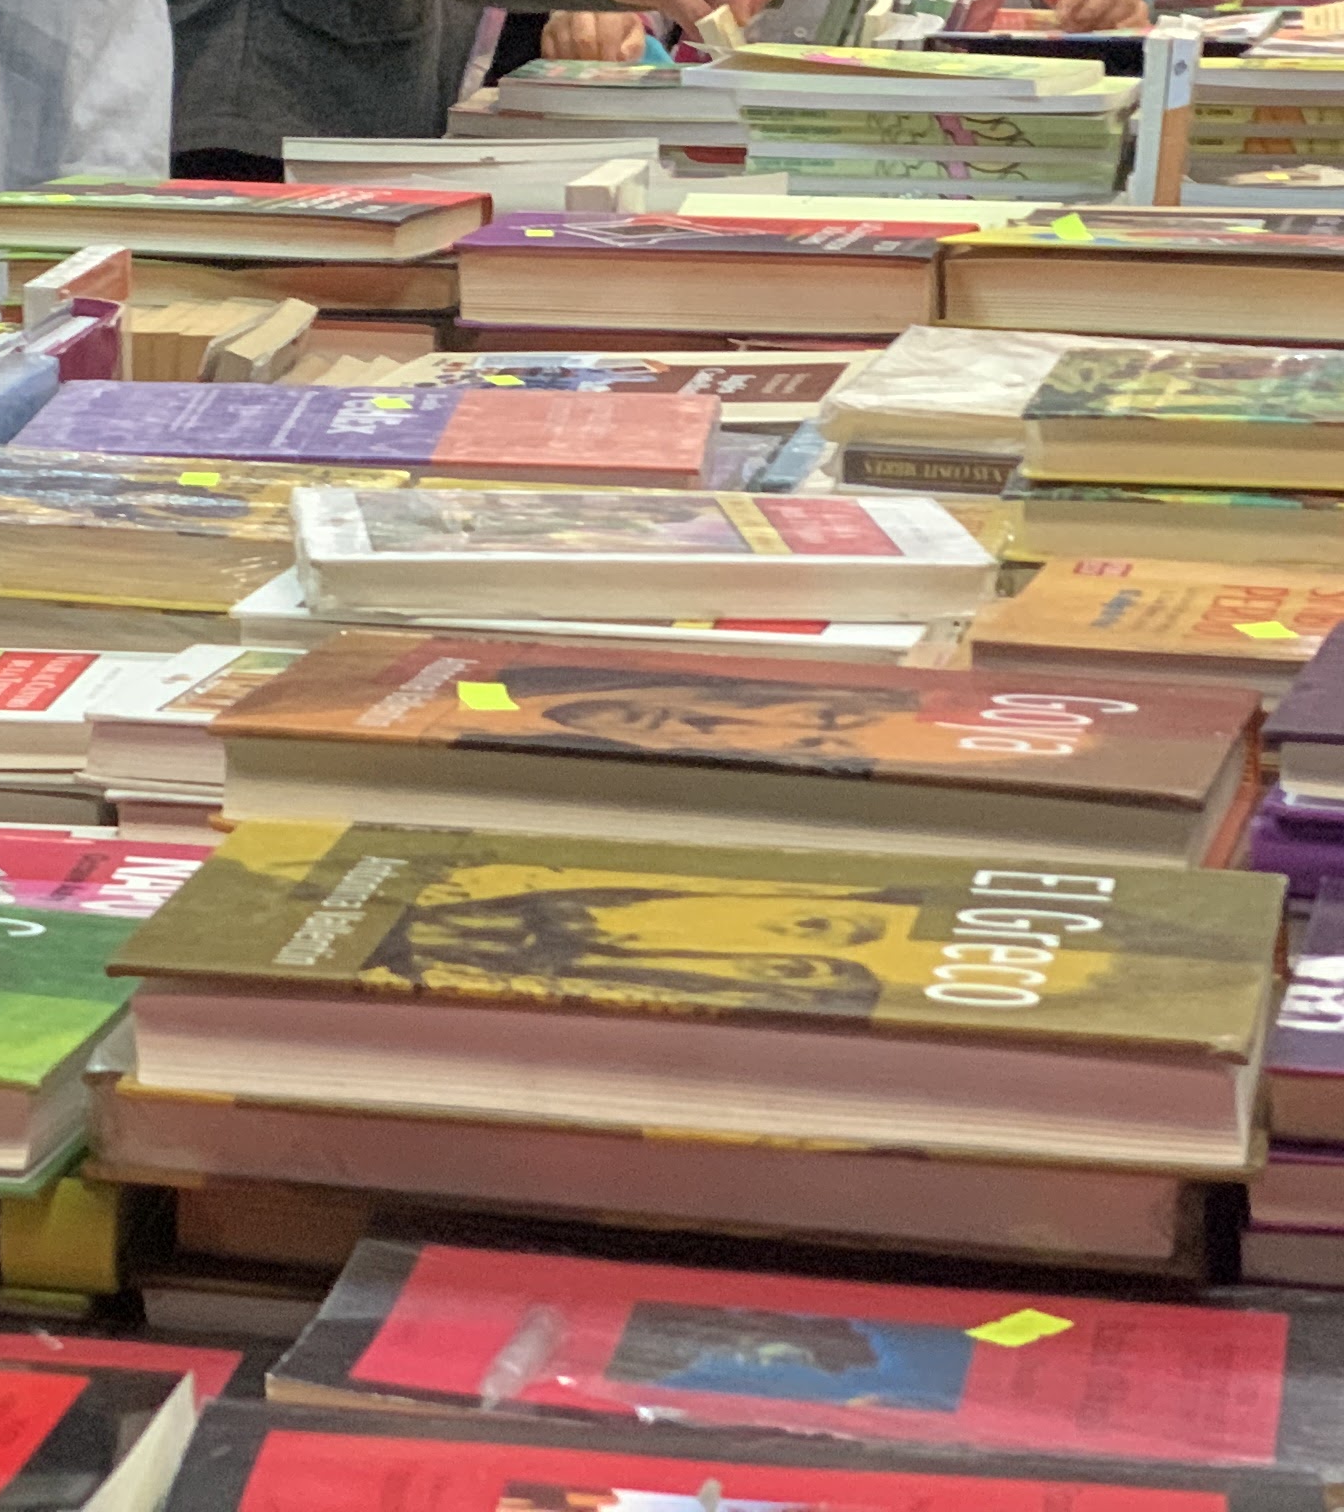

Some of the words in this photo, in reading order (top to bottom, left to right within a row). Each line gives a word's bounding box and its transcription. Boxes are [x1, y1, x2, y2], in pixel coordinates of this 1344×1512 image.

[934, 693, 1139, 755] Goya
[969, 869, 1116, 903] El
[923, 907, 1103, 1008] Greco
